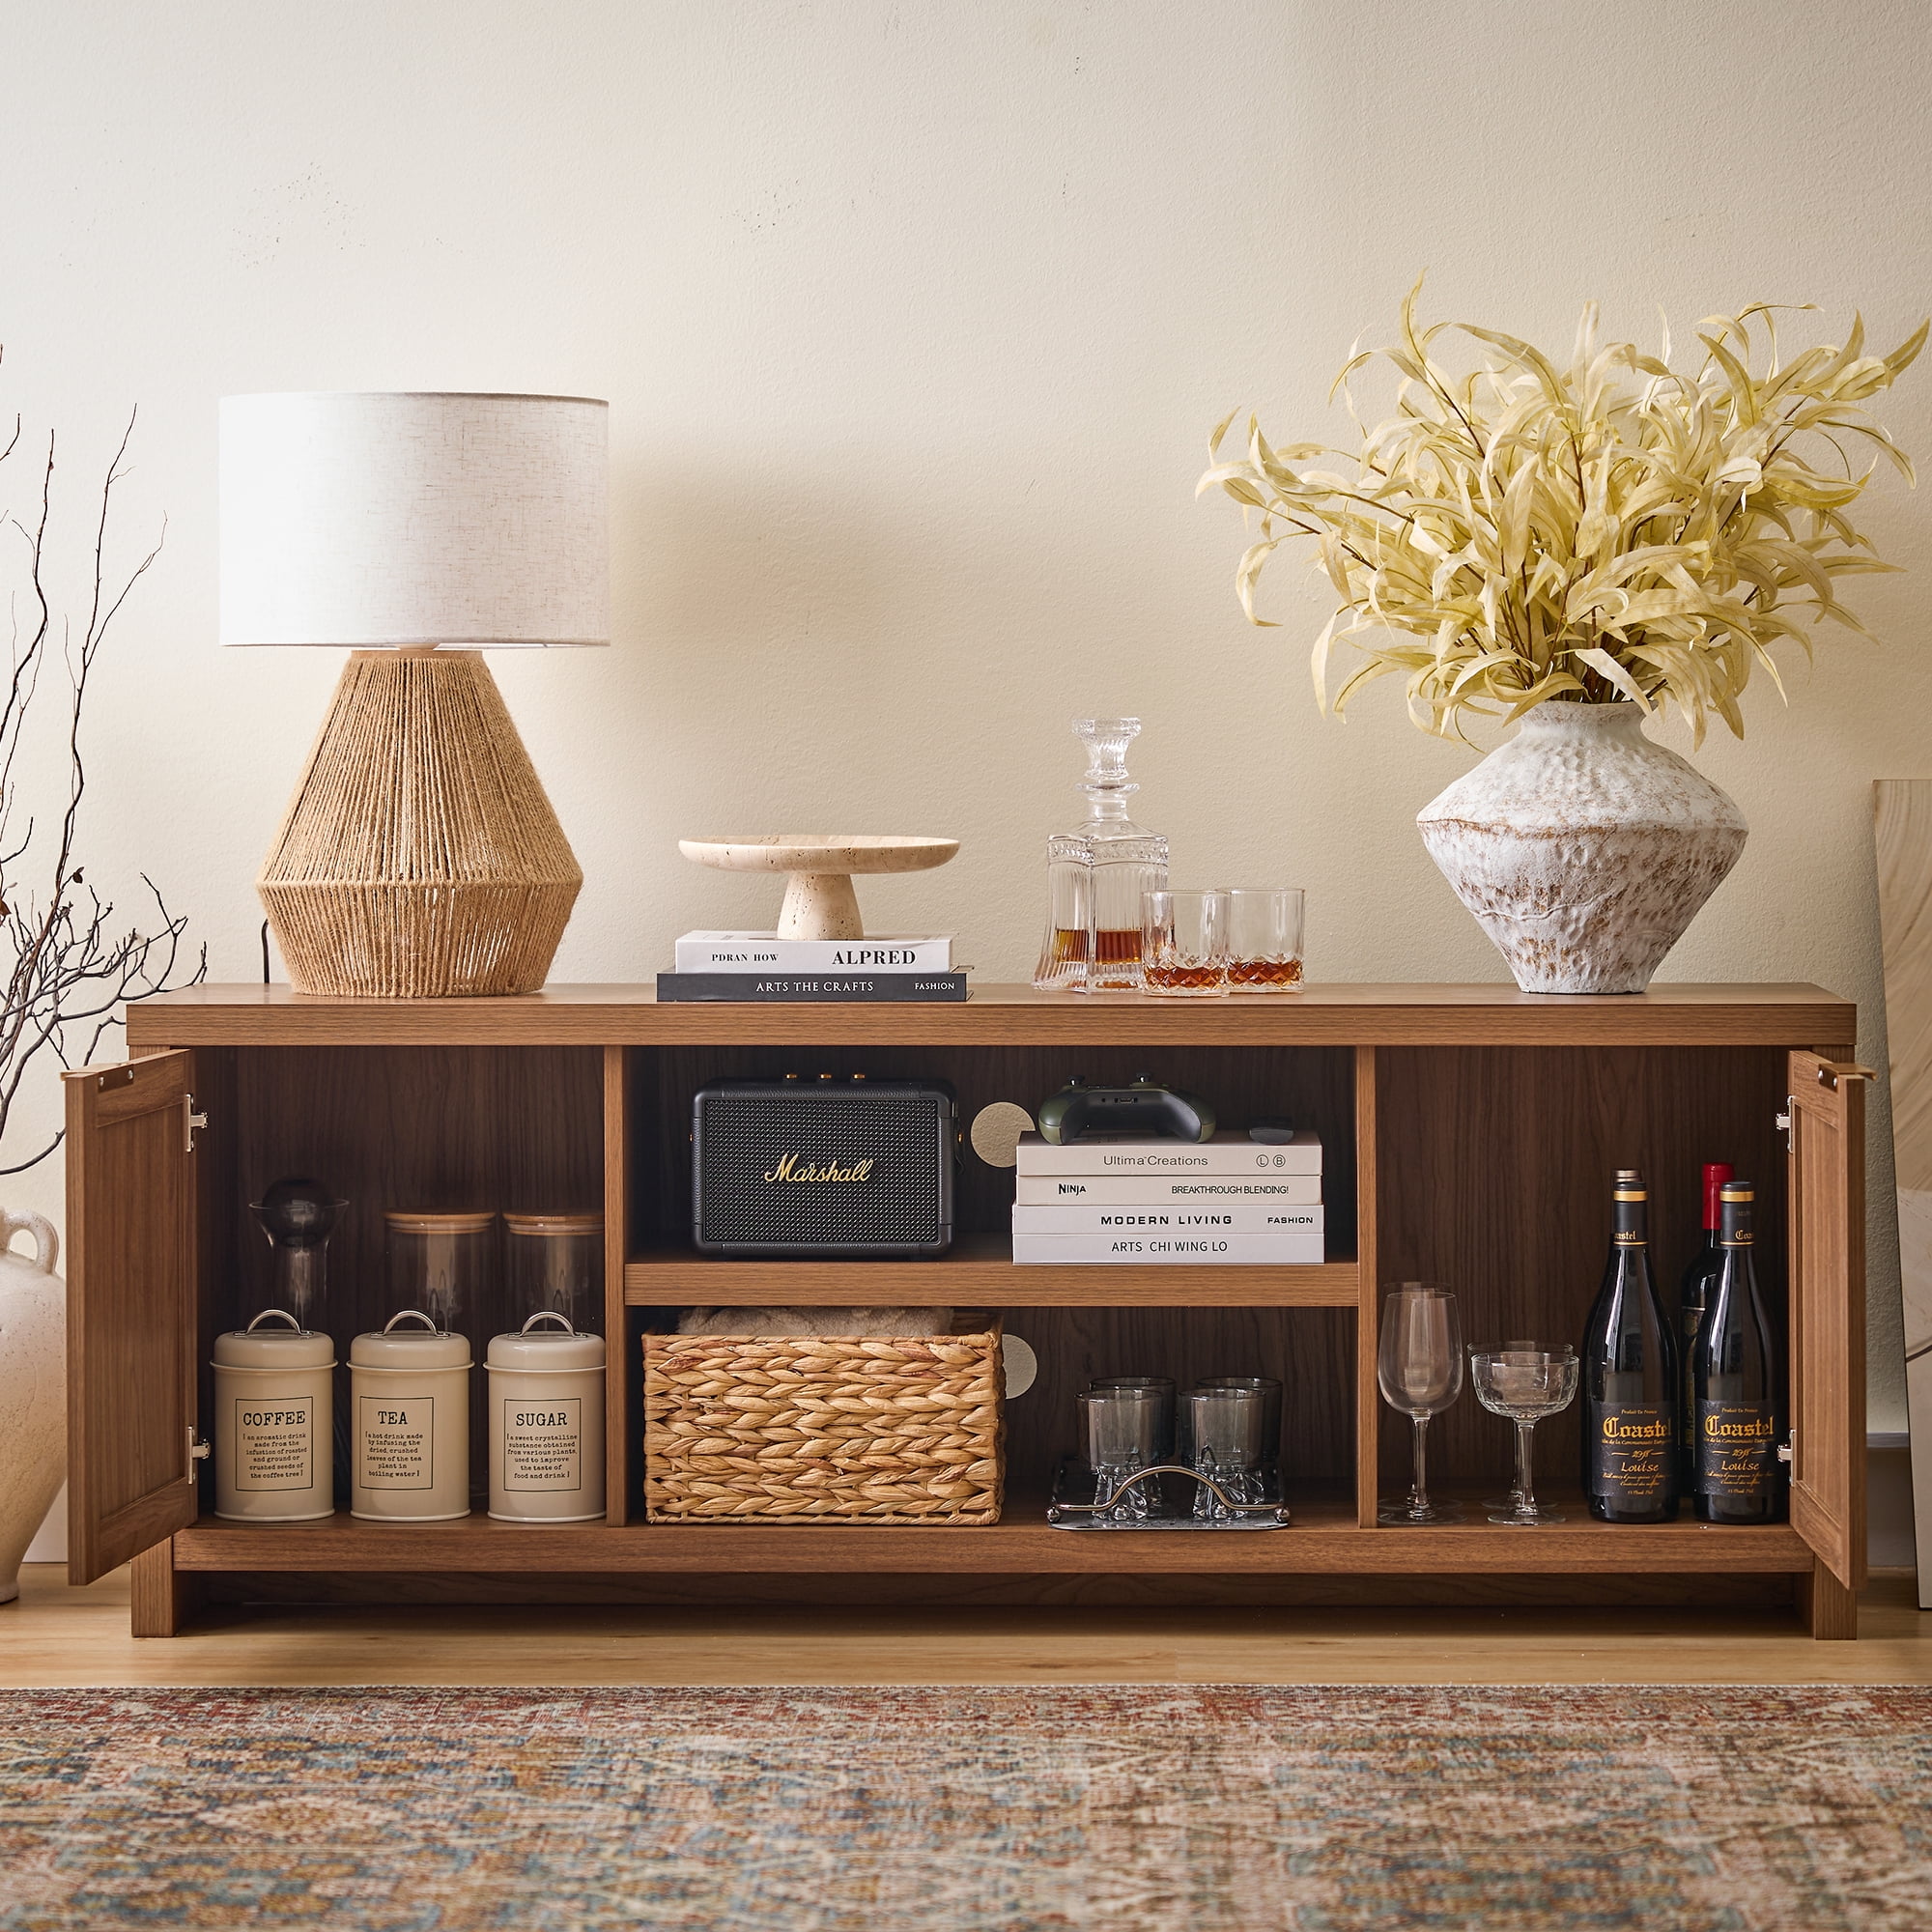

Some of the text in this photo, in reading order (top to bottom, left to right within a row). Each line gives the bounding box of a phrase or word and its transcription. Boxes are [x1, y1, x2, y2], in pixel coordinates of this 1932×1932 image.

[711, 950, 917, 965] PDRAN HOW ALPRED
[755, 981, 955, 993] ARTS THE CRAFTS FASHION
[764, 1152, 874, 1182] Marshall
[1171, 1185, 1290, 1194] BREAKTHROUGH BLENDING!
[1100, 1215, 1170, 1225] MODERN
[1178, 1215, 1233, 1225] LIVING
[1111, 1241, 1228, 1252] ARTS CHI WING LO
[242, 1410, 306, 1426] COFFEE
[378, 1410, 408, 1425] TEA
[516, 1412, 568, 1427] SUGAR
[1704, 1414, 1775, 1436] Coastel
[535, 1434, 578, 1442] crystalline
[1621, 1461, 1660, 1472] Louise
[1720, 1460, 1760, 1471] Louise
